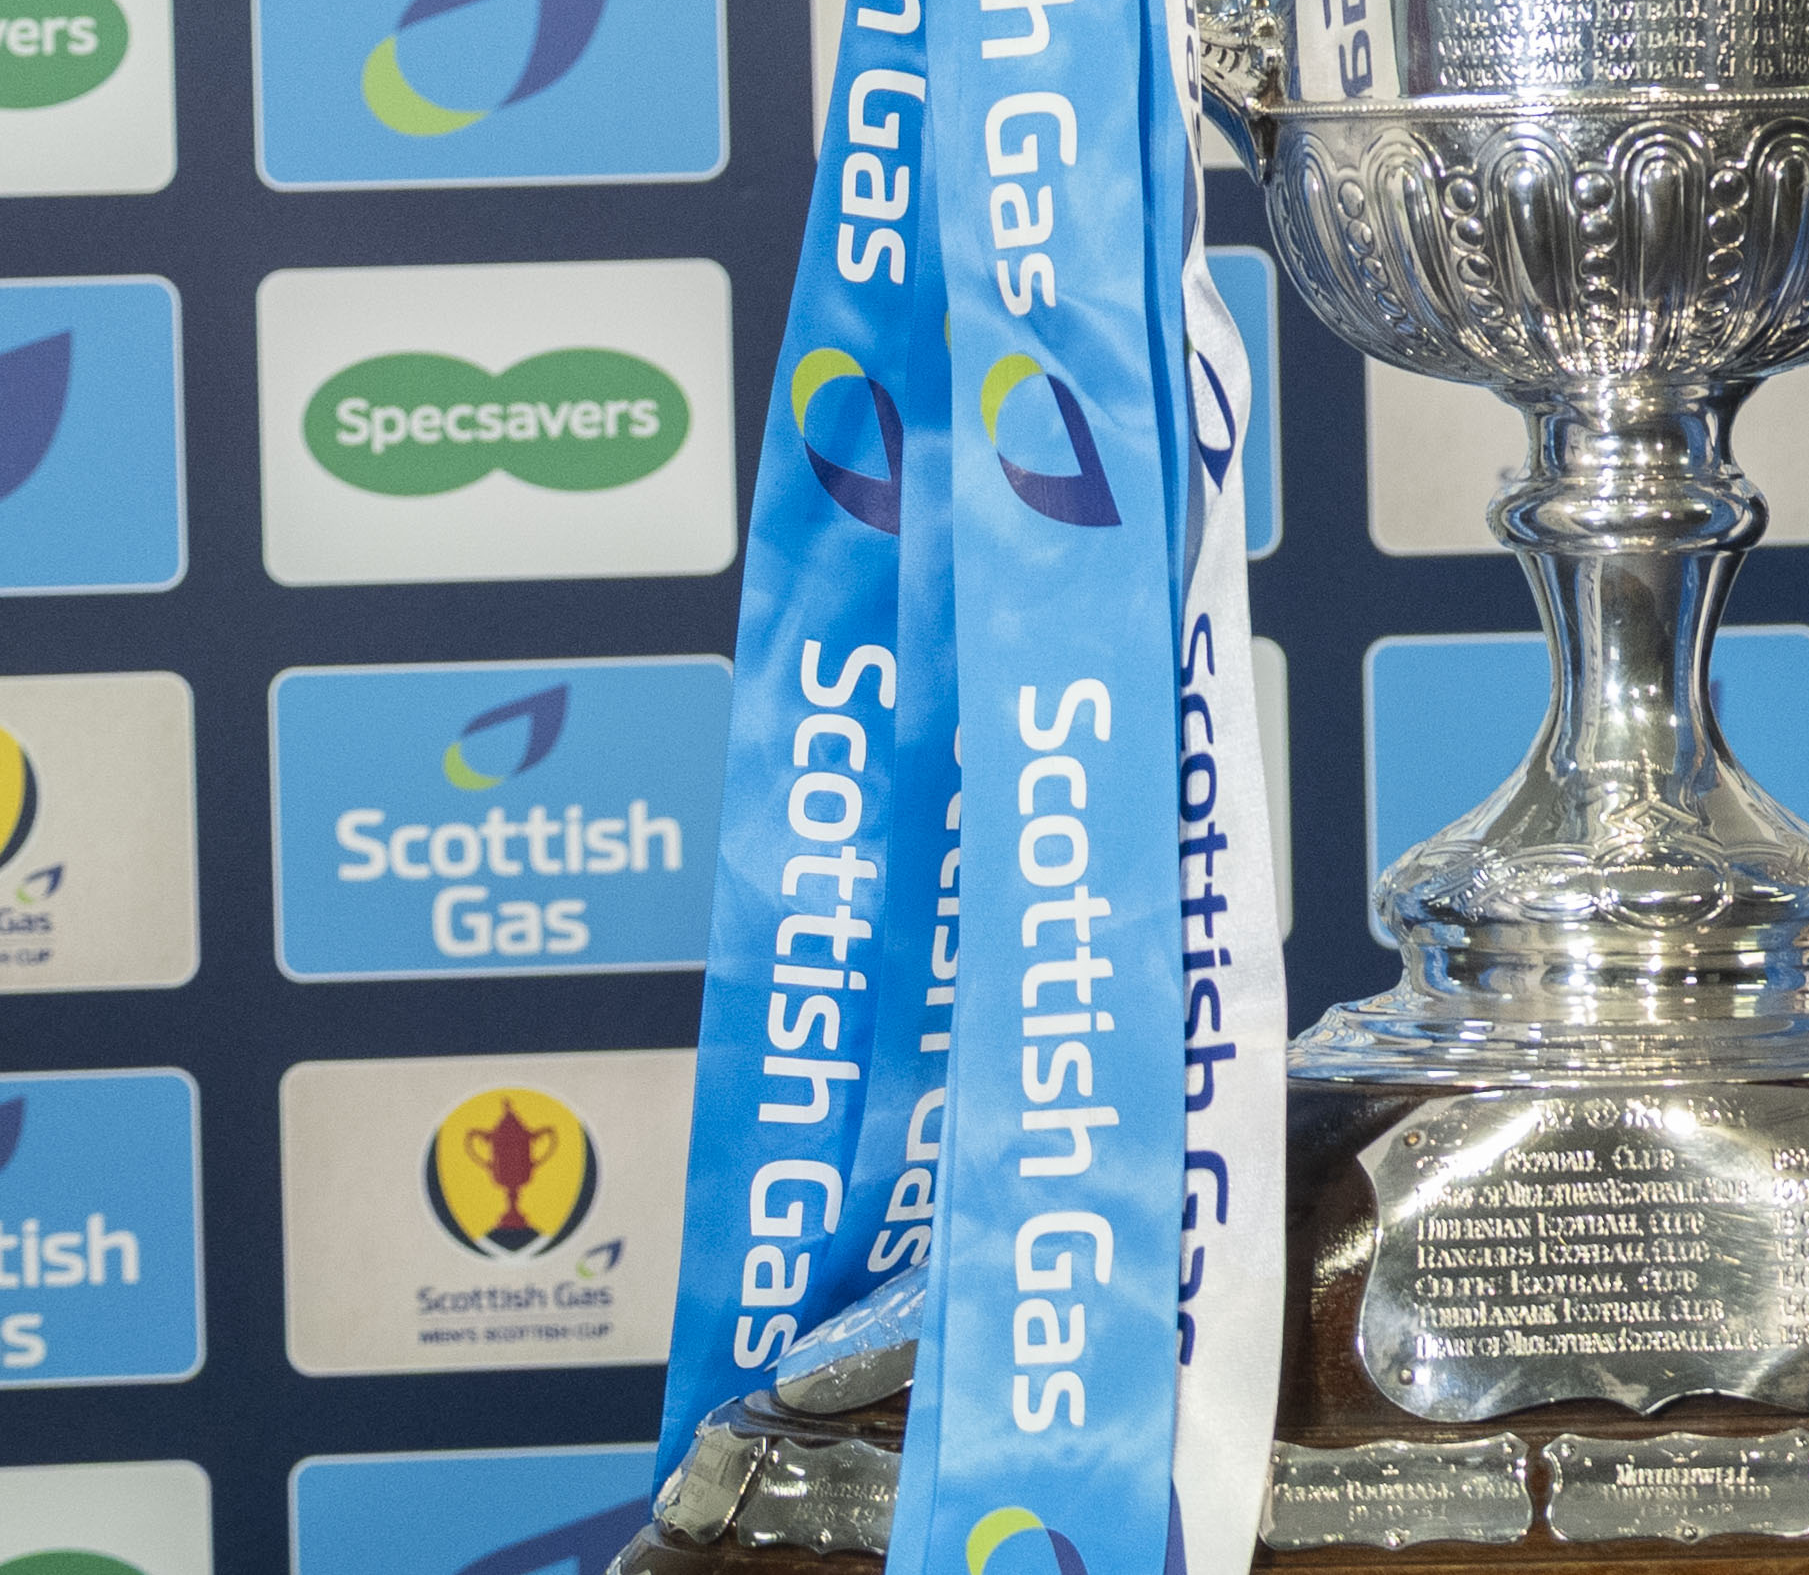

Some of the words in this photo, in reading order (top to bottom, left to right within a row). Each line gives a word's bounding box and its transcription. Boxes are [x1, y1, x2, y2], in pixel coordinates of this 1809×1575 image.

[837, 68, 929, 286] Gas
[985, 91, 1078, 317] Gas
[336, 397, 660, 455] Specsavers
[336, 799, 682, 881] Scottish
[432, 885, 590, 957] Gas
[757, 640, 896, 1123] Scottish
[1018, 678, 1119, 1179] Scottish
[415, 1285, 548, 1315] Scottish
[553, 1282, 613, 1309] Gas
[576, 1322, 611, 1340] CUP
[732, 1159, 843, 1372] Gas
[1012, 1211, 1115, 1433] Gas
